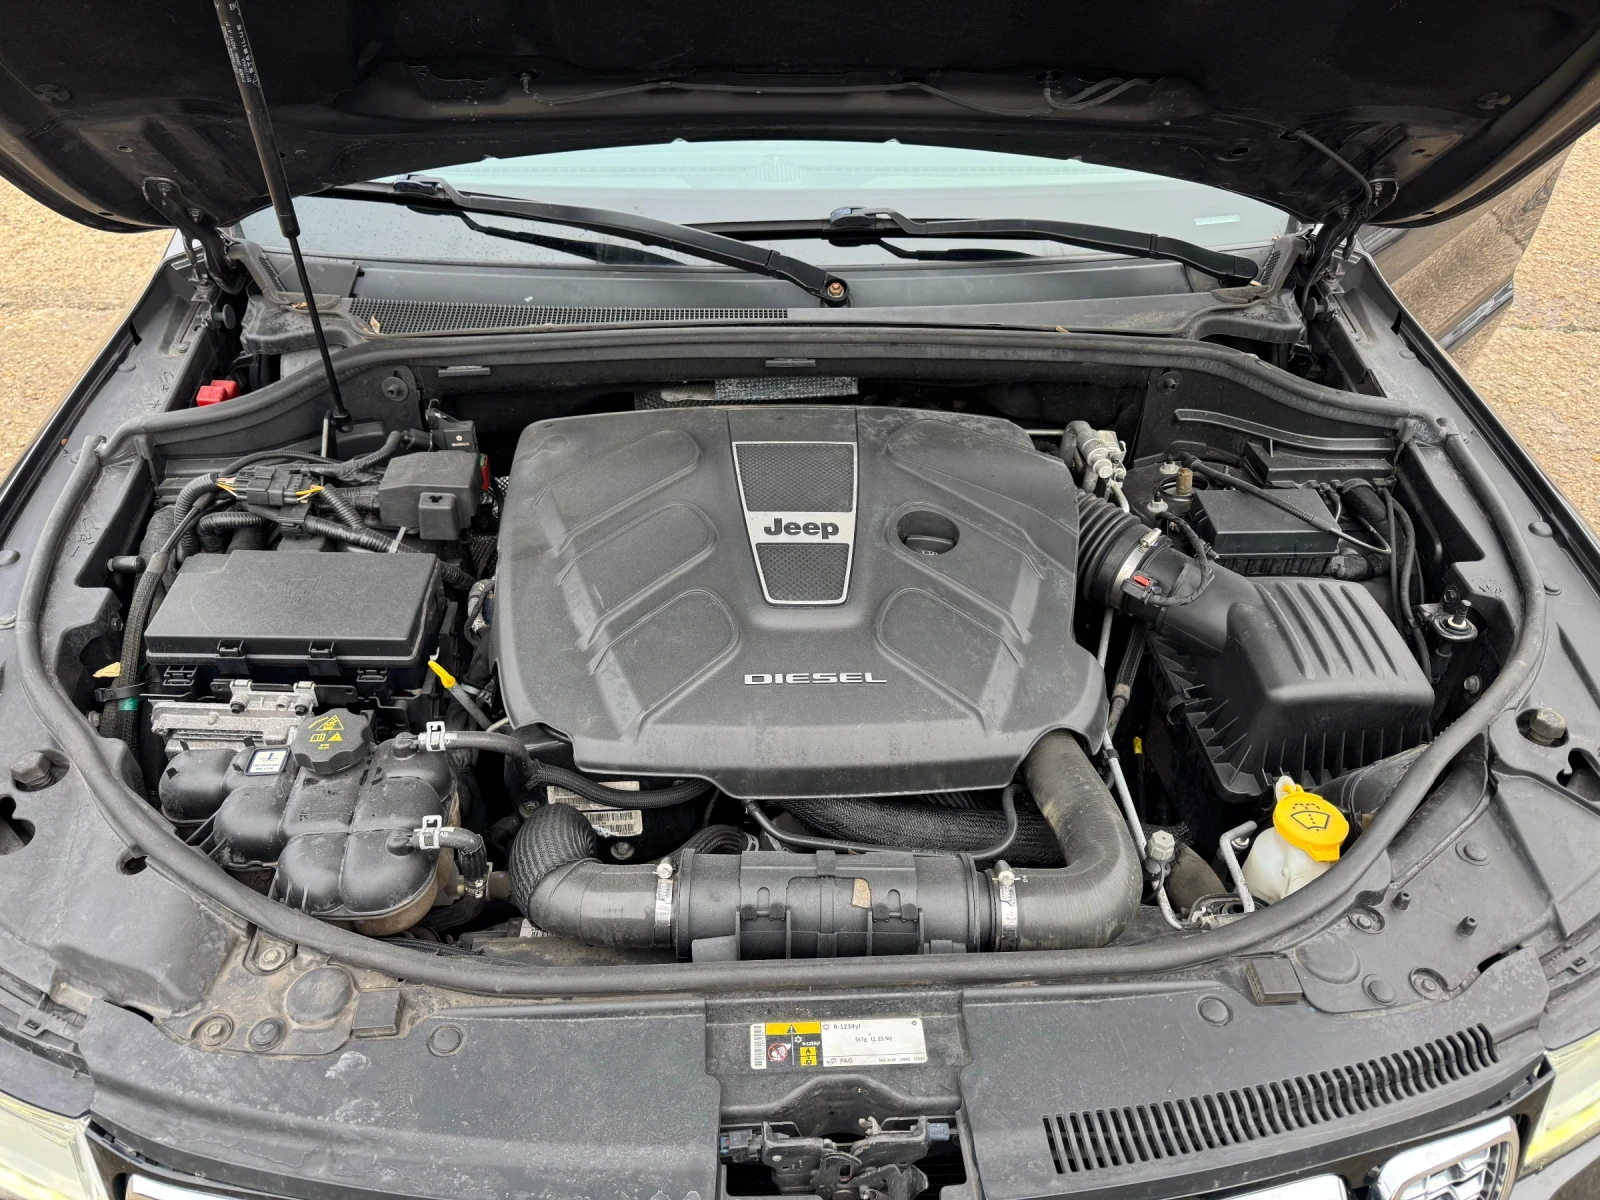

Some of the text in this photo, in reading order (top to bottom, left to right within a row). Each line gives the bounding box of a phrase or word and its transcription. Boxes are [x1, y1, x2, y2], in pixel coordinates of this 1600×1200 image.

[237, 24, 254, 74] STABILUS
[764, 518, 839, 539] Jeep
[744, 672, 887, 685] DIESEL
[833, 1022, 861, 1031] R-1234yf
